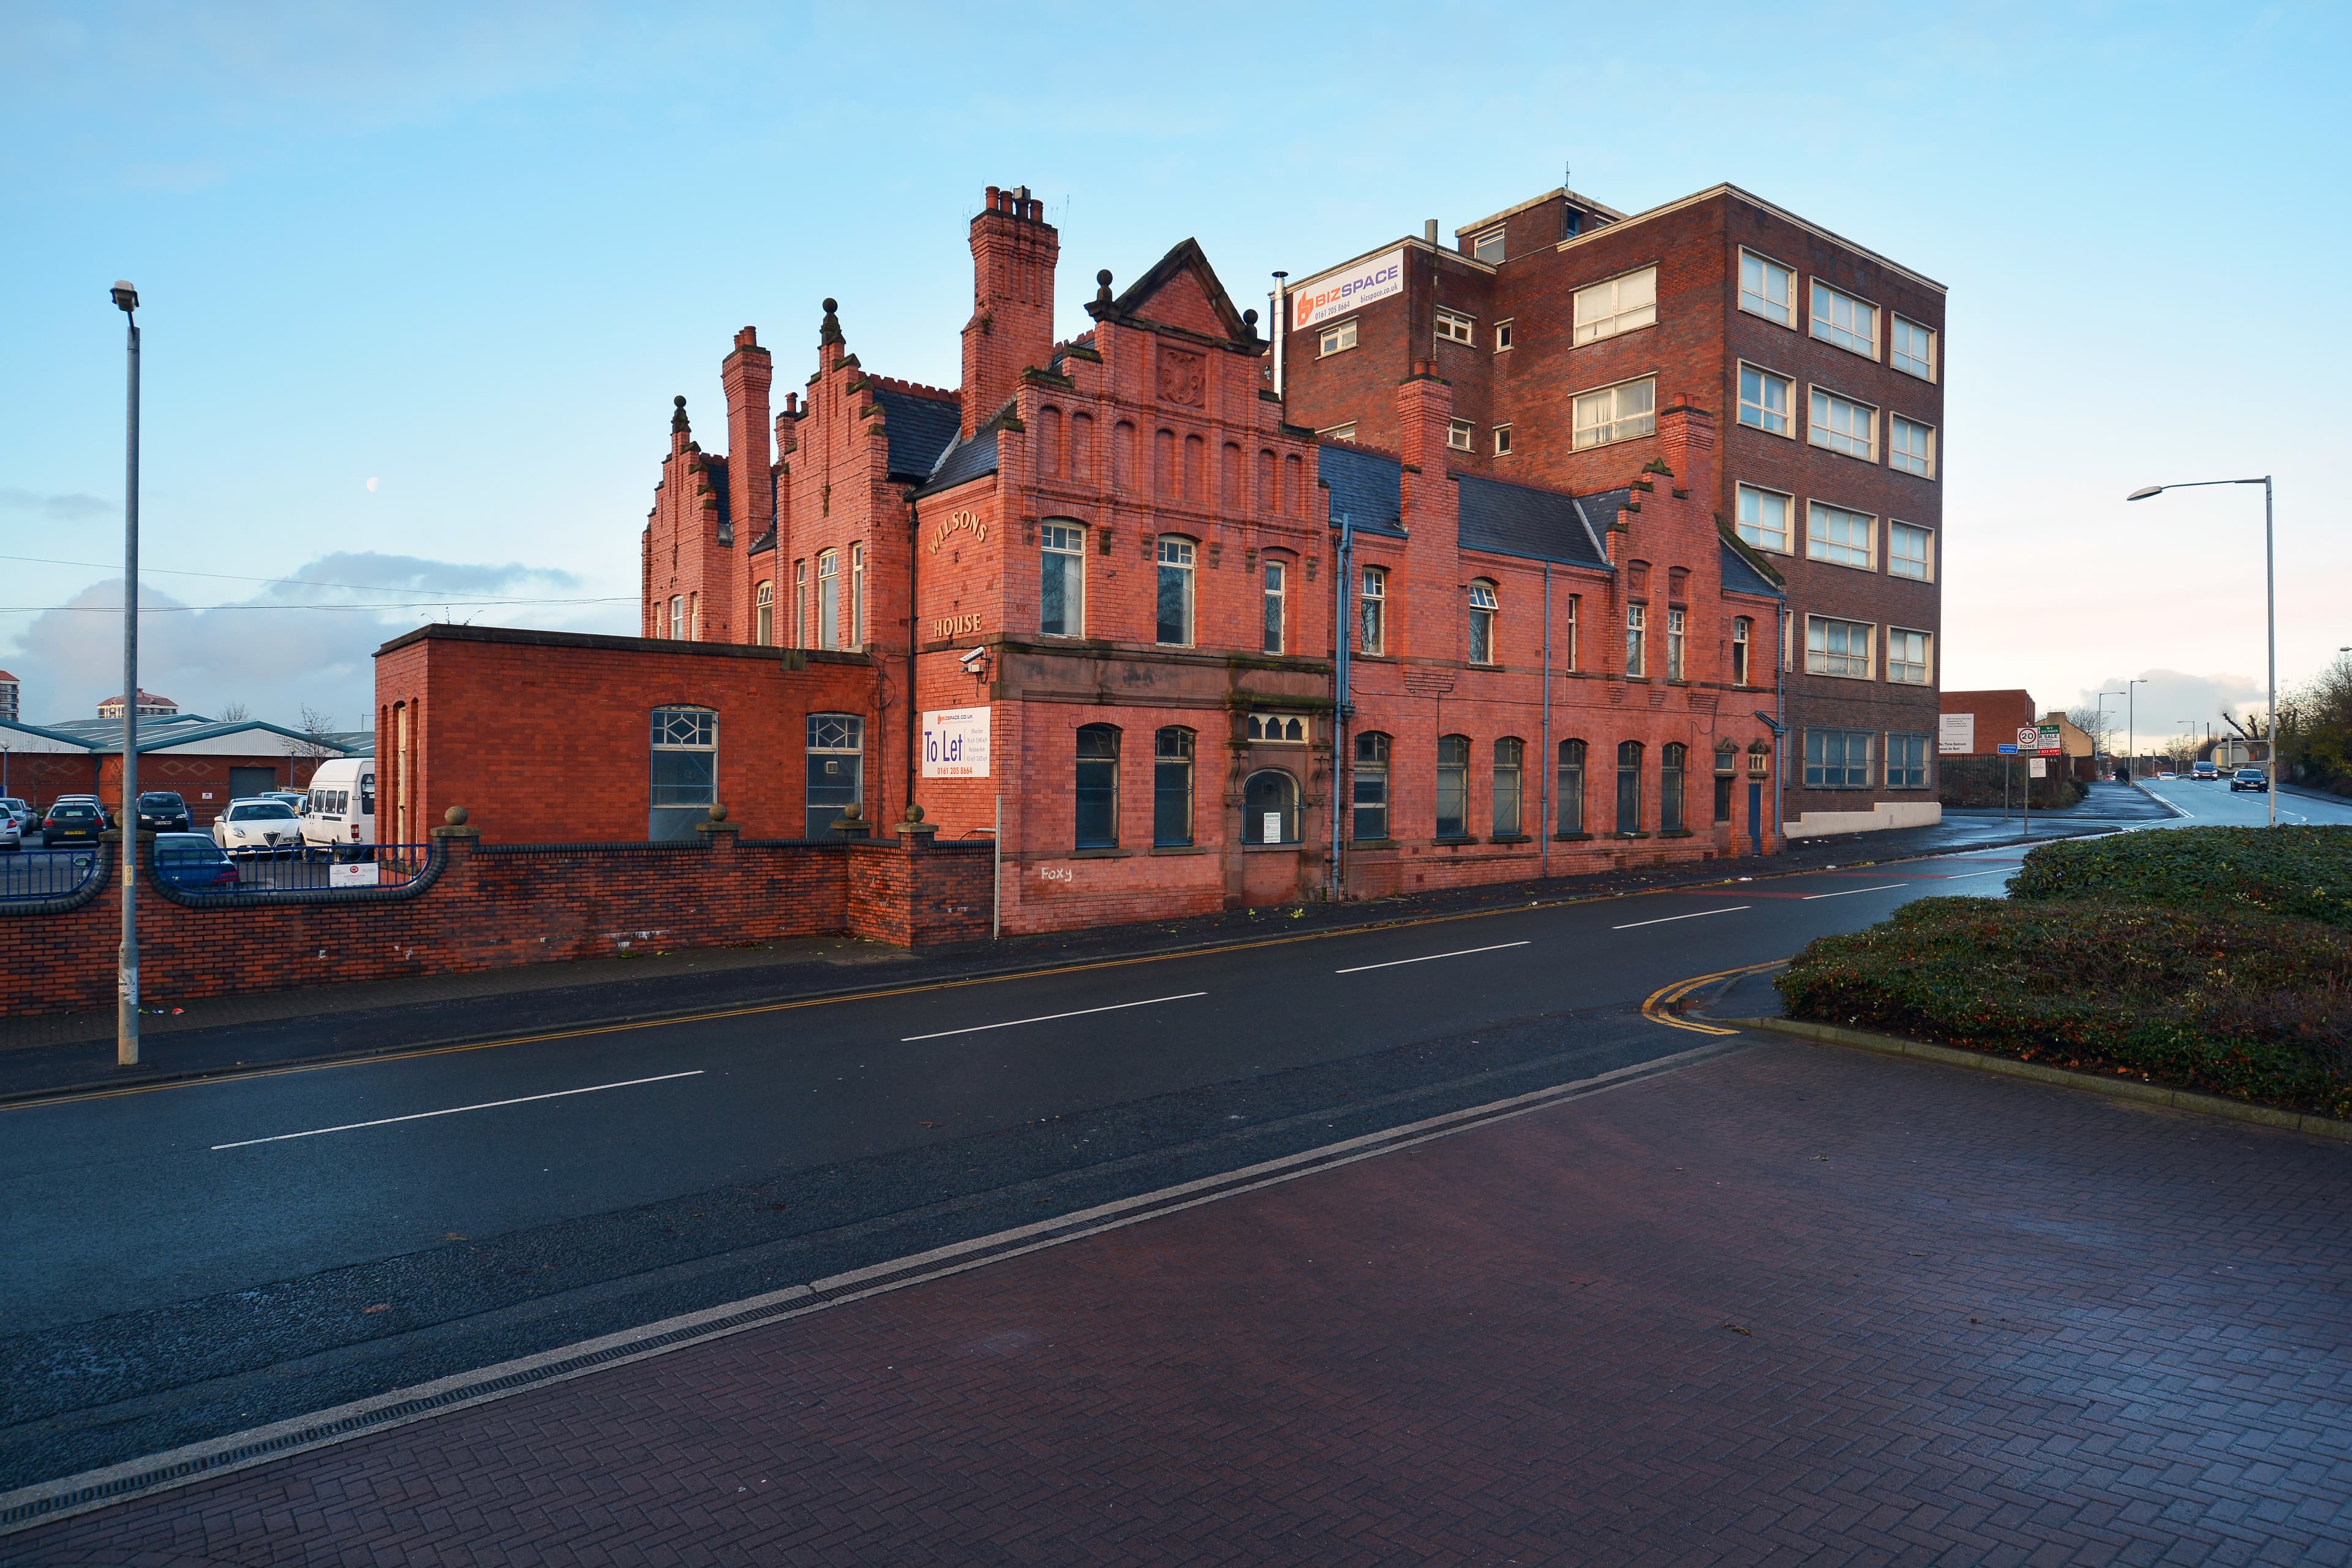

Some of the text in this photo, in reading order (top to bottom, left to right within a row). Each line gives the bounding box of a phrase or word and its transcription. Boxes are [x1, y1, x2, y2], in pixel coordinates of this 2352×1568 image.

[1315, 265, 1398, 308] BIZSPACE
[1360, 282, 1398, 303] bizspace.co.uk
[1315, 301, 1350, 320] 0161 205 8664
[928, 510, 987, 555] WILSONS
[934, 613, 982, 638] HOUSE
[924, 730, 963, 762] To Let
[1041, 867, 1072, 883] Foxy
